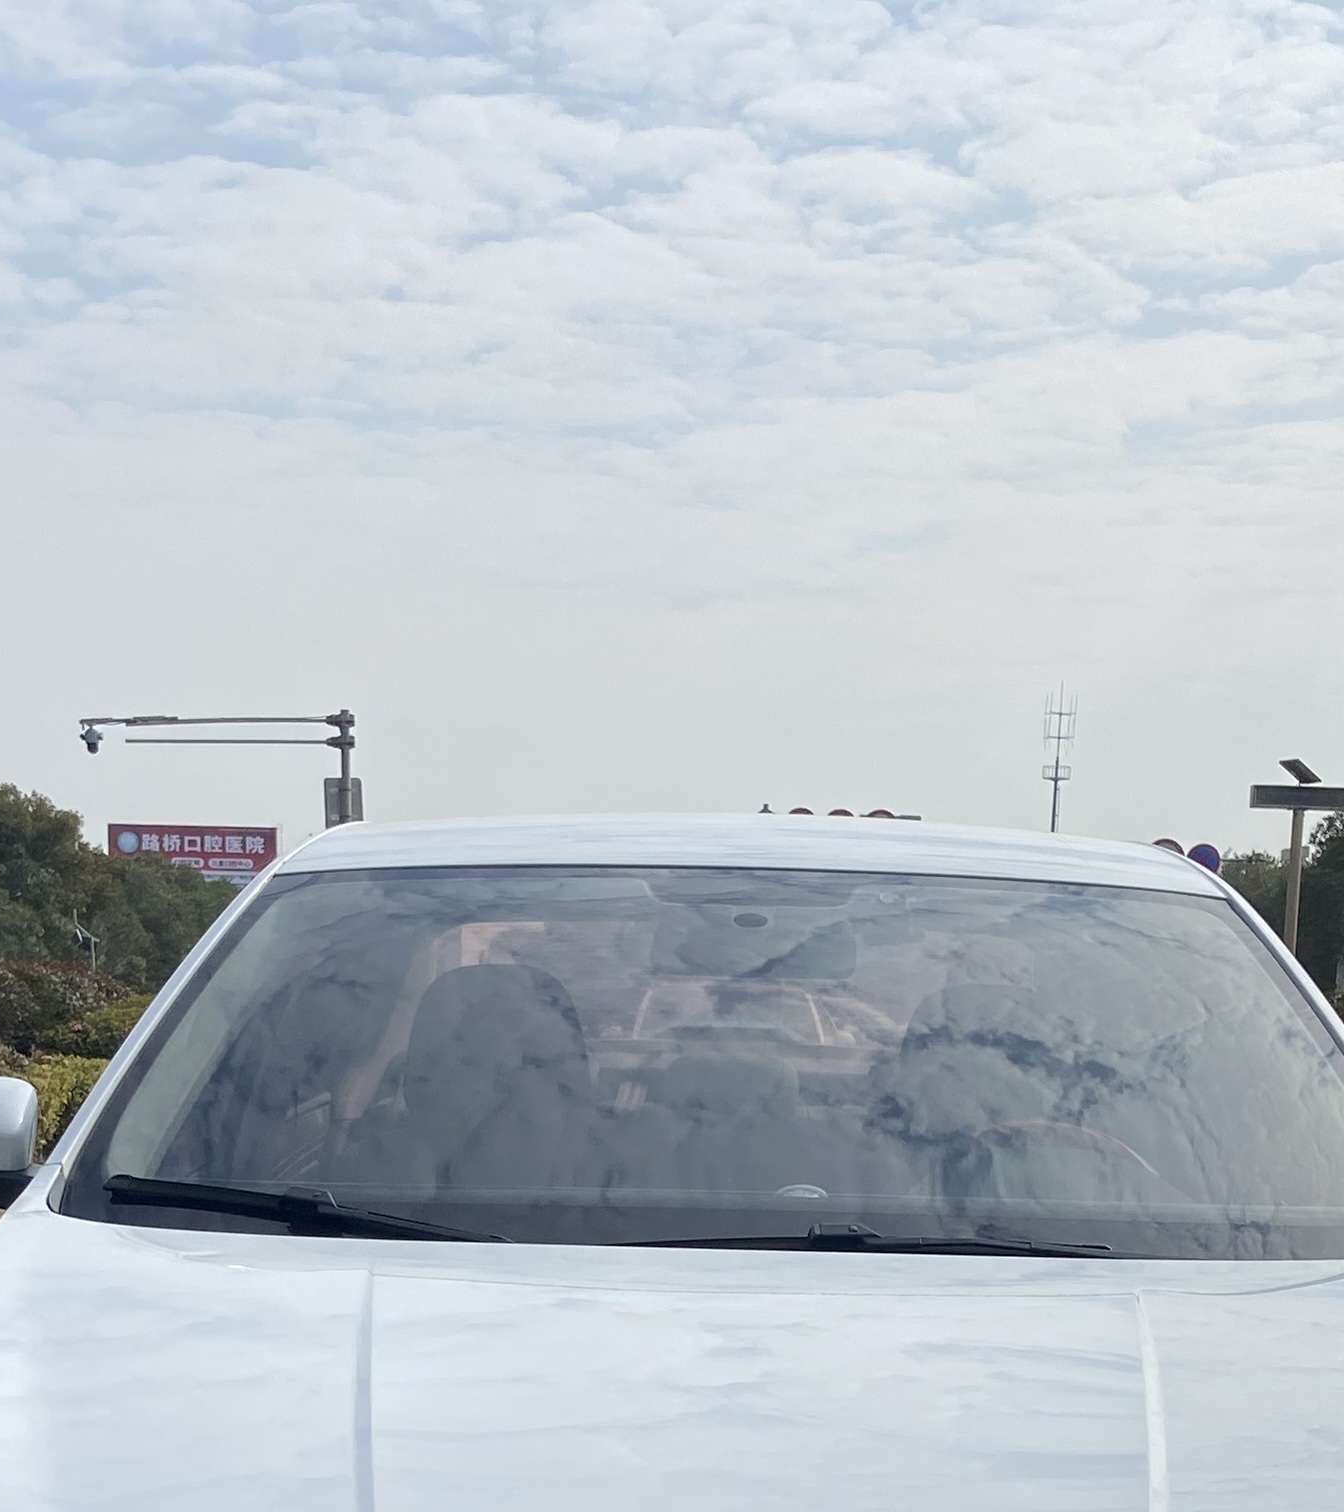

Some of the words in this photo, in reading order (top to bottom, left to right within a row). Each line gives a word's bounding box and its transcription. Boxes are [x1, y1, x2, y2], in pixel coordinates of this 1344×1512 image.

[141, 833, 265, 854] 路桥口腔医院
